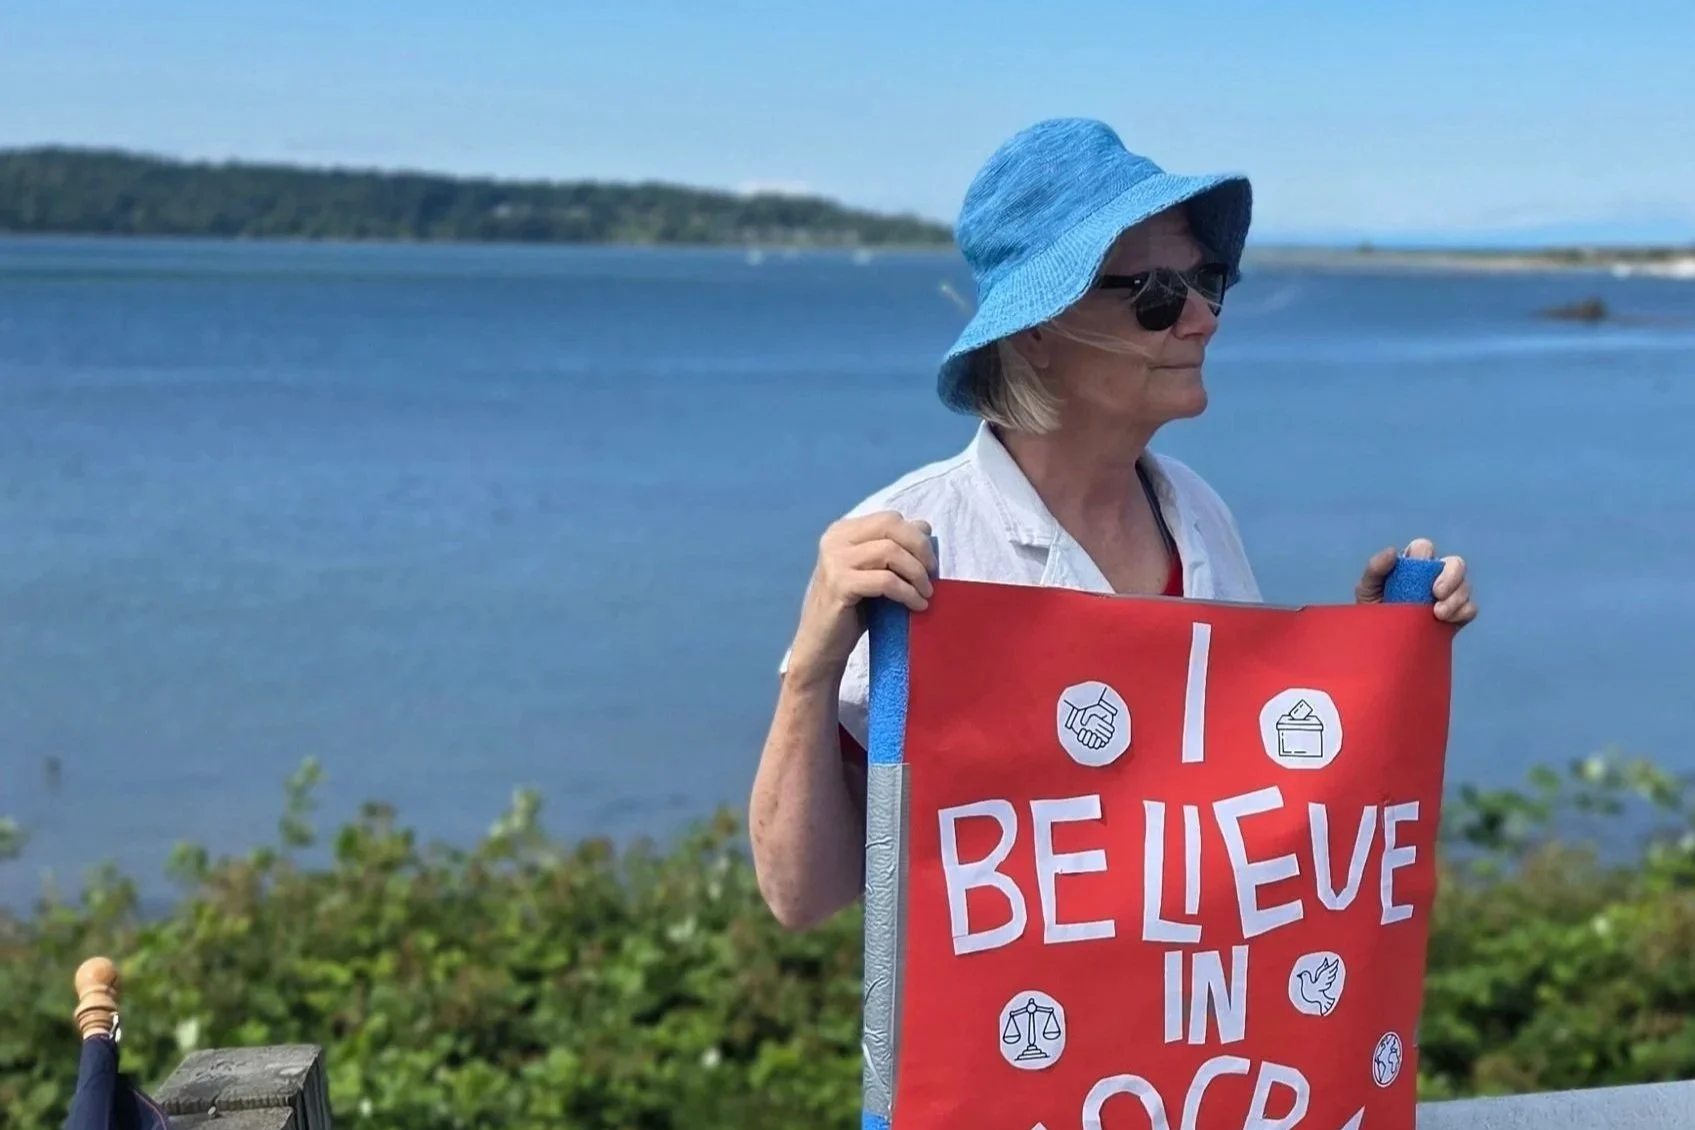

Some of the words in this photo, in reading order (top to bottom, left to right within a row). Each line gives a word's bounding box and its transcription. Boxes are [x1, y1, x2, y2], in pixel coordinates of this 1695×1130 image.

[1181, 622, 1212, 763] I
[938, 786, 1420, 956] BELIEVE
[1164, 945, 1249, 1044] IN
